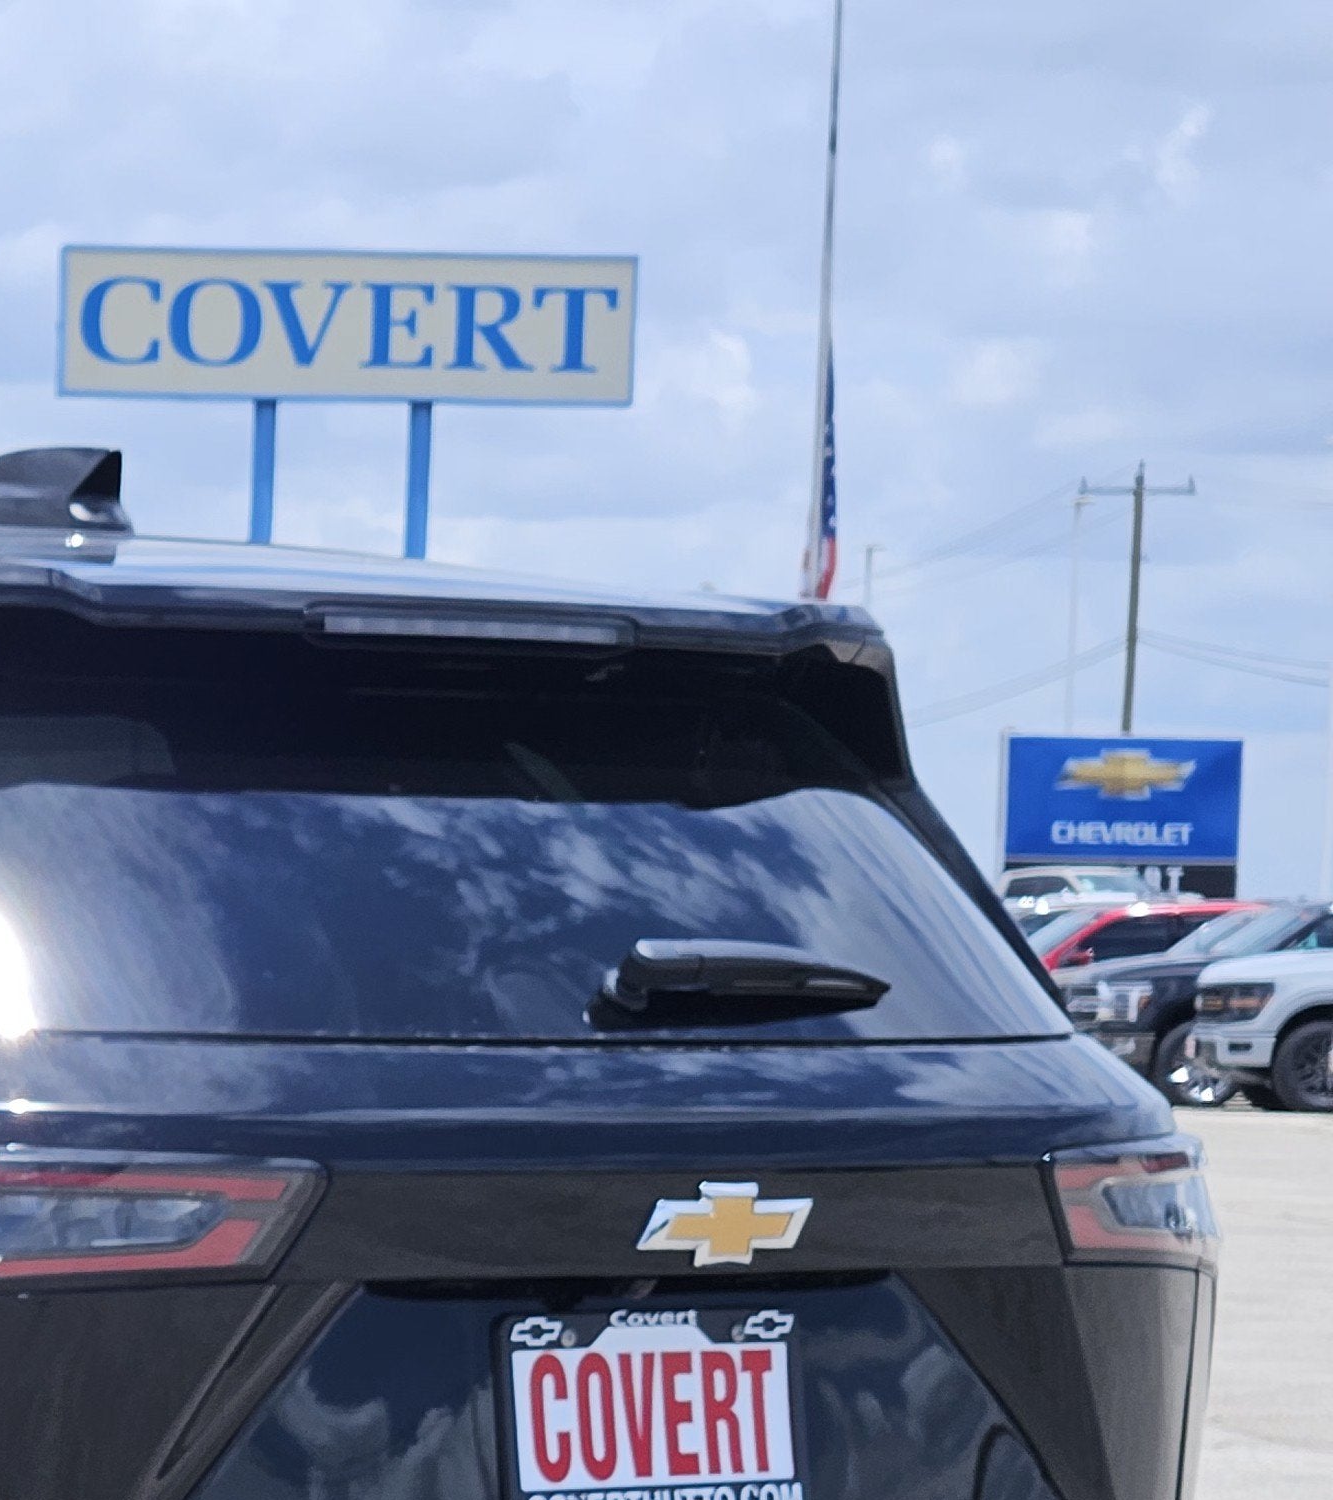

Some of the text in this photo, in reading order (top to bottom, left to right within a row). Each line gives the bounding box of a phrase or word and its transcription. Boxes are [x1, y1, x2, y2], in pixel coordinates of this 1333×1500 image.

[79, 275, 620, 374] COVERT
[1052, 820, 1193, 846] CHEVROLET
[529, 1349, 772, 1483] COVERT
